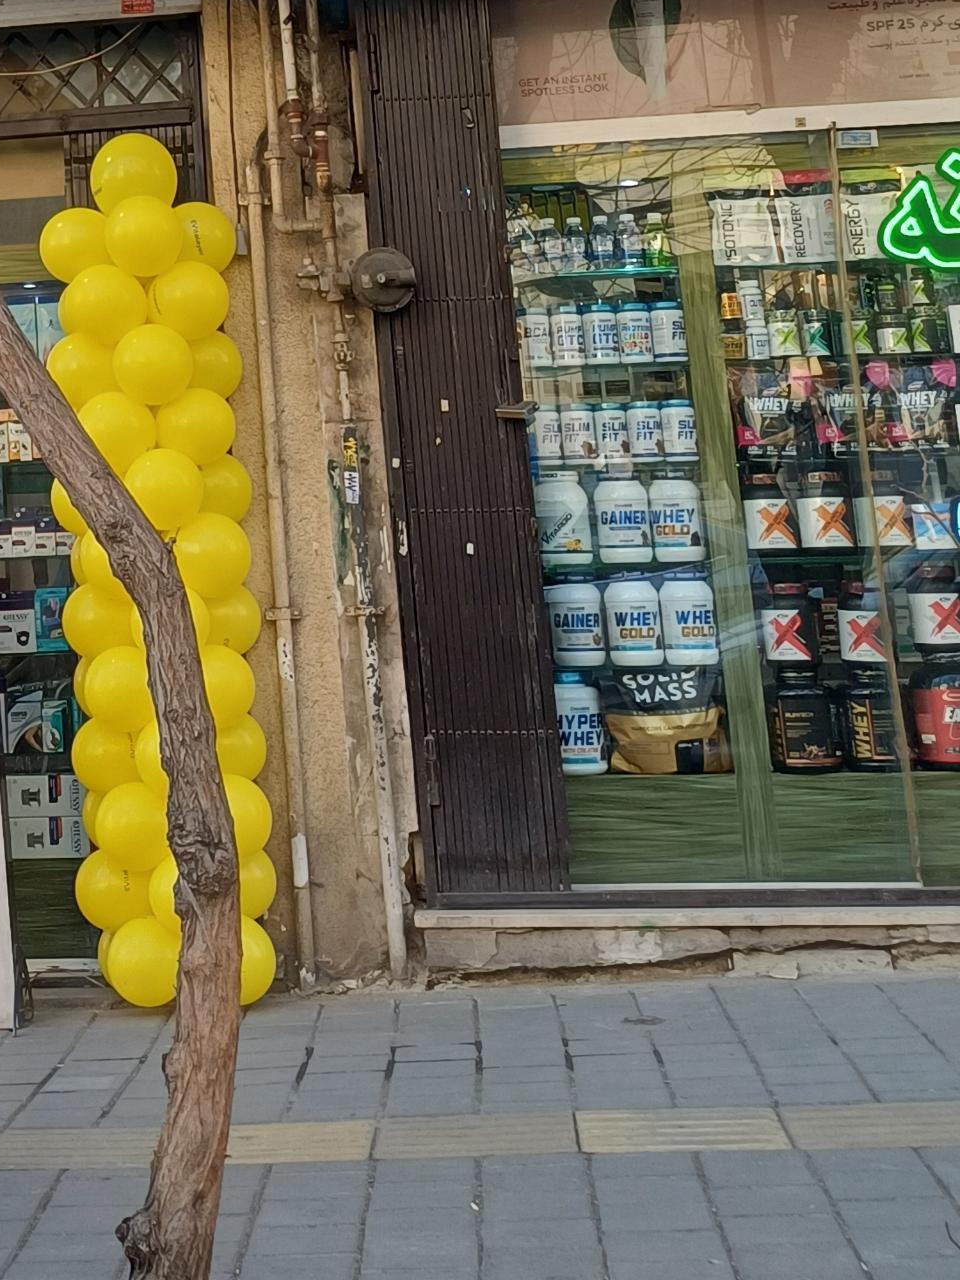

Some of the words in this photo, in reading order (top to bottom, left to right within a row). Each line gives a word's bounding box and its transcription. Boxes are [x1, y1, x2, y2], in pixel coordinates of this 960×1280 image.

[866, 20, 895, 32] SPF
[898, 18, 916, 31] 25
[518, 77, 540, 88] GET
[543, 76, 560, 86] AN
[561, 72, 609, 86] INSTANT
[520, 86, 575, 98] SPOTLESS
[578, 82, 609, 94] LOOK
[789, 200, 807, 259] RECOVERY
[845, 198, 866, 257] ENERGY
[600, 509, 647, 526] GAINER
[649, 508, 695, 524] WHEY
[655, 524, 691, 537] GOLD
[553, 612, 600, 629] GAINER
[614, 611, 658, 627] WHEY
[675, 610, 714, 625] WHE
[619, 628, 656, 640] GOLD
[681, 626, 715, 638] GOLD
[633, 681, 698, 704] MASS
[559, 729, 604, 747] WHEY
[850, 701, 873, 759] WHEY
